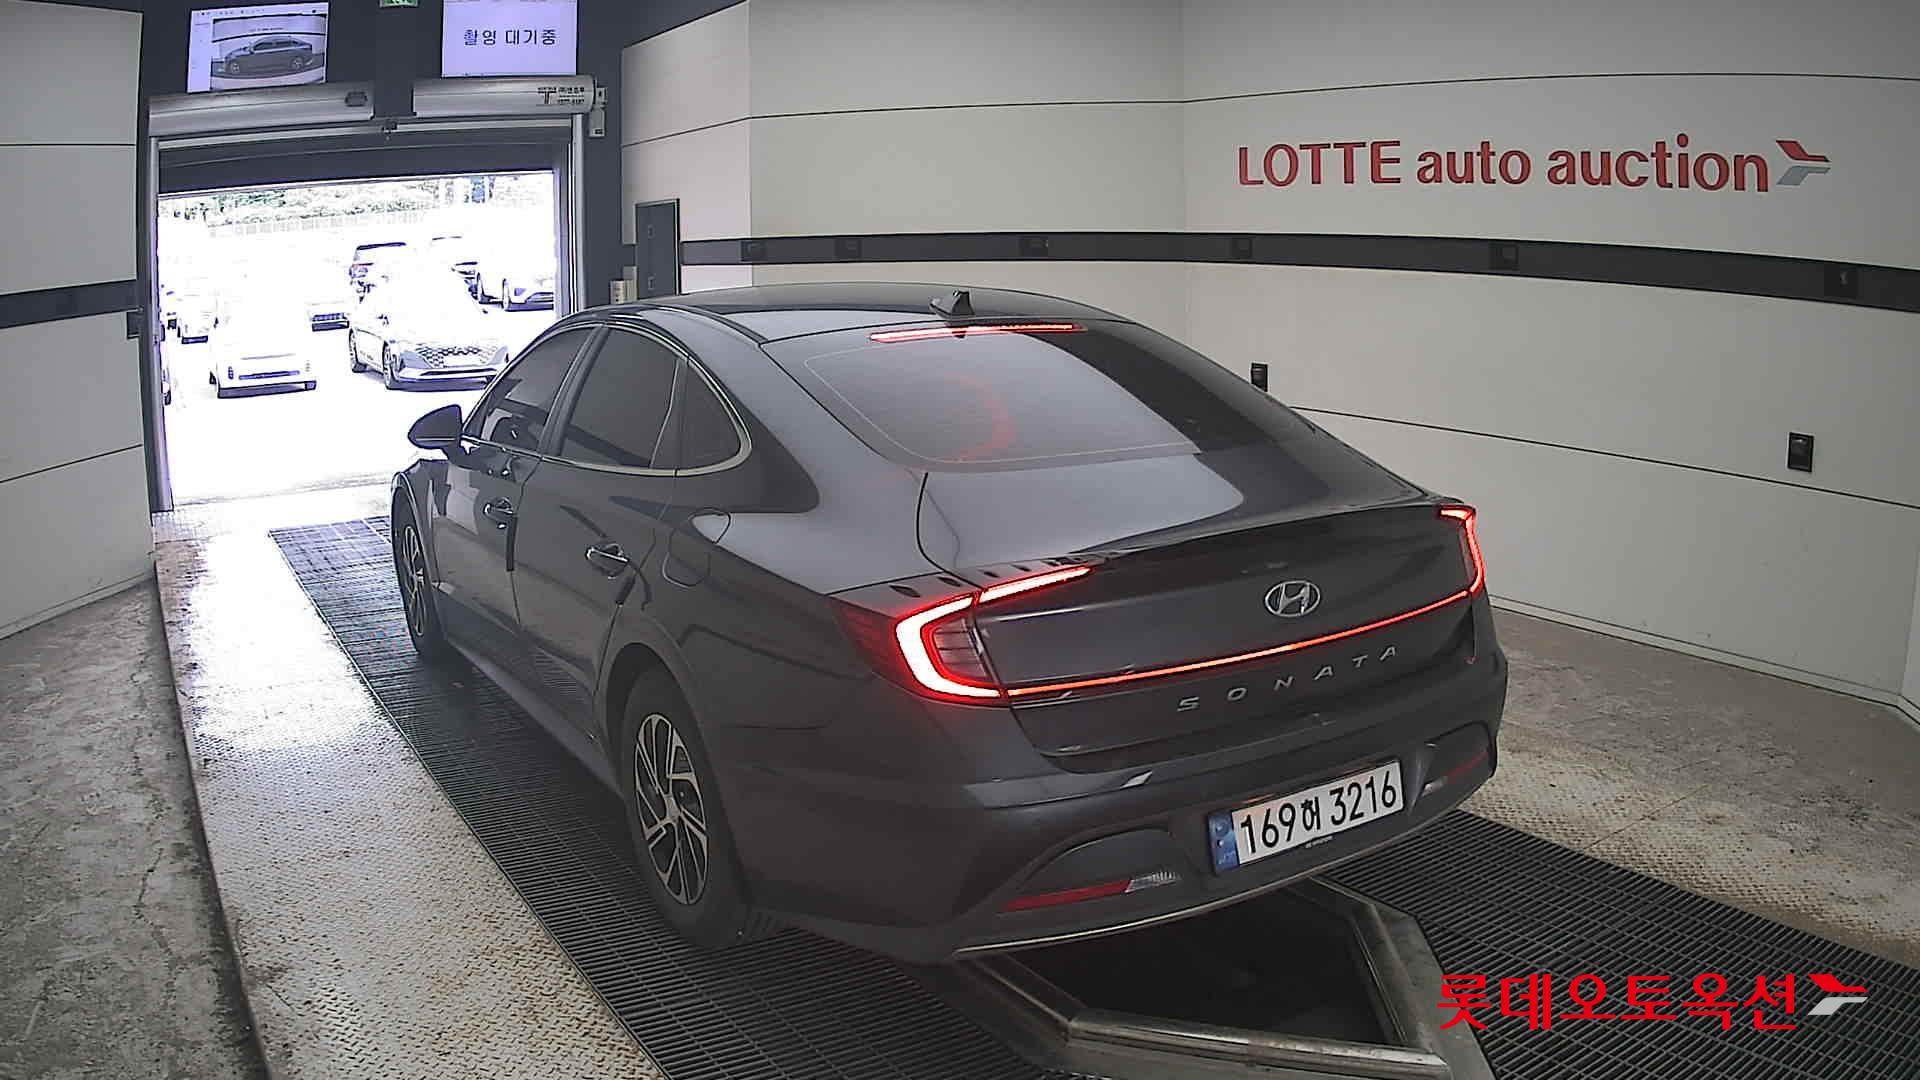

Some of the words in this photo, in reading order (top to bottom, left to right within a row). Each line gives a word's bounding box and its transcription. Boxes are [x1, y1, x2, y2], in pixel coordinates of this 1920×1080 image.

[463, 29, 497, 46] 촬영
[505, 29, 557, 46] 대기중
[1237, 139, 1401, 187] LOTTE
[1416, 140, 1532, 185] auto
[1547, 133, 1769, 192] auction
[1176, 645, 1398, 712] SONATA
[1240, 796, 1321, 854] 169허
[1329, 770, 1397, 826] 3216
